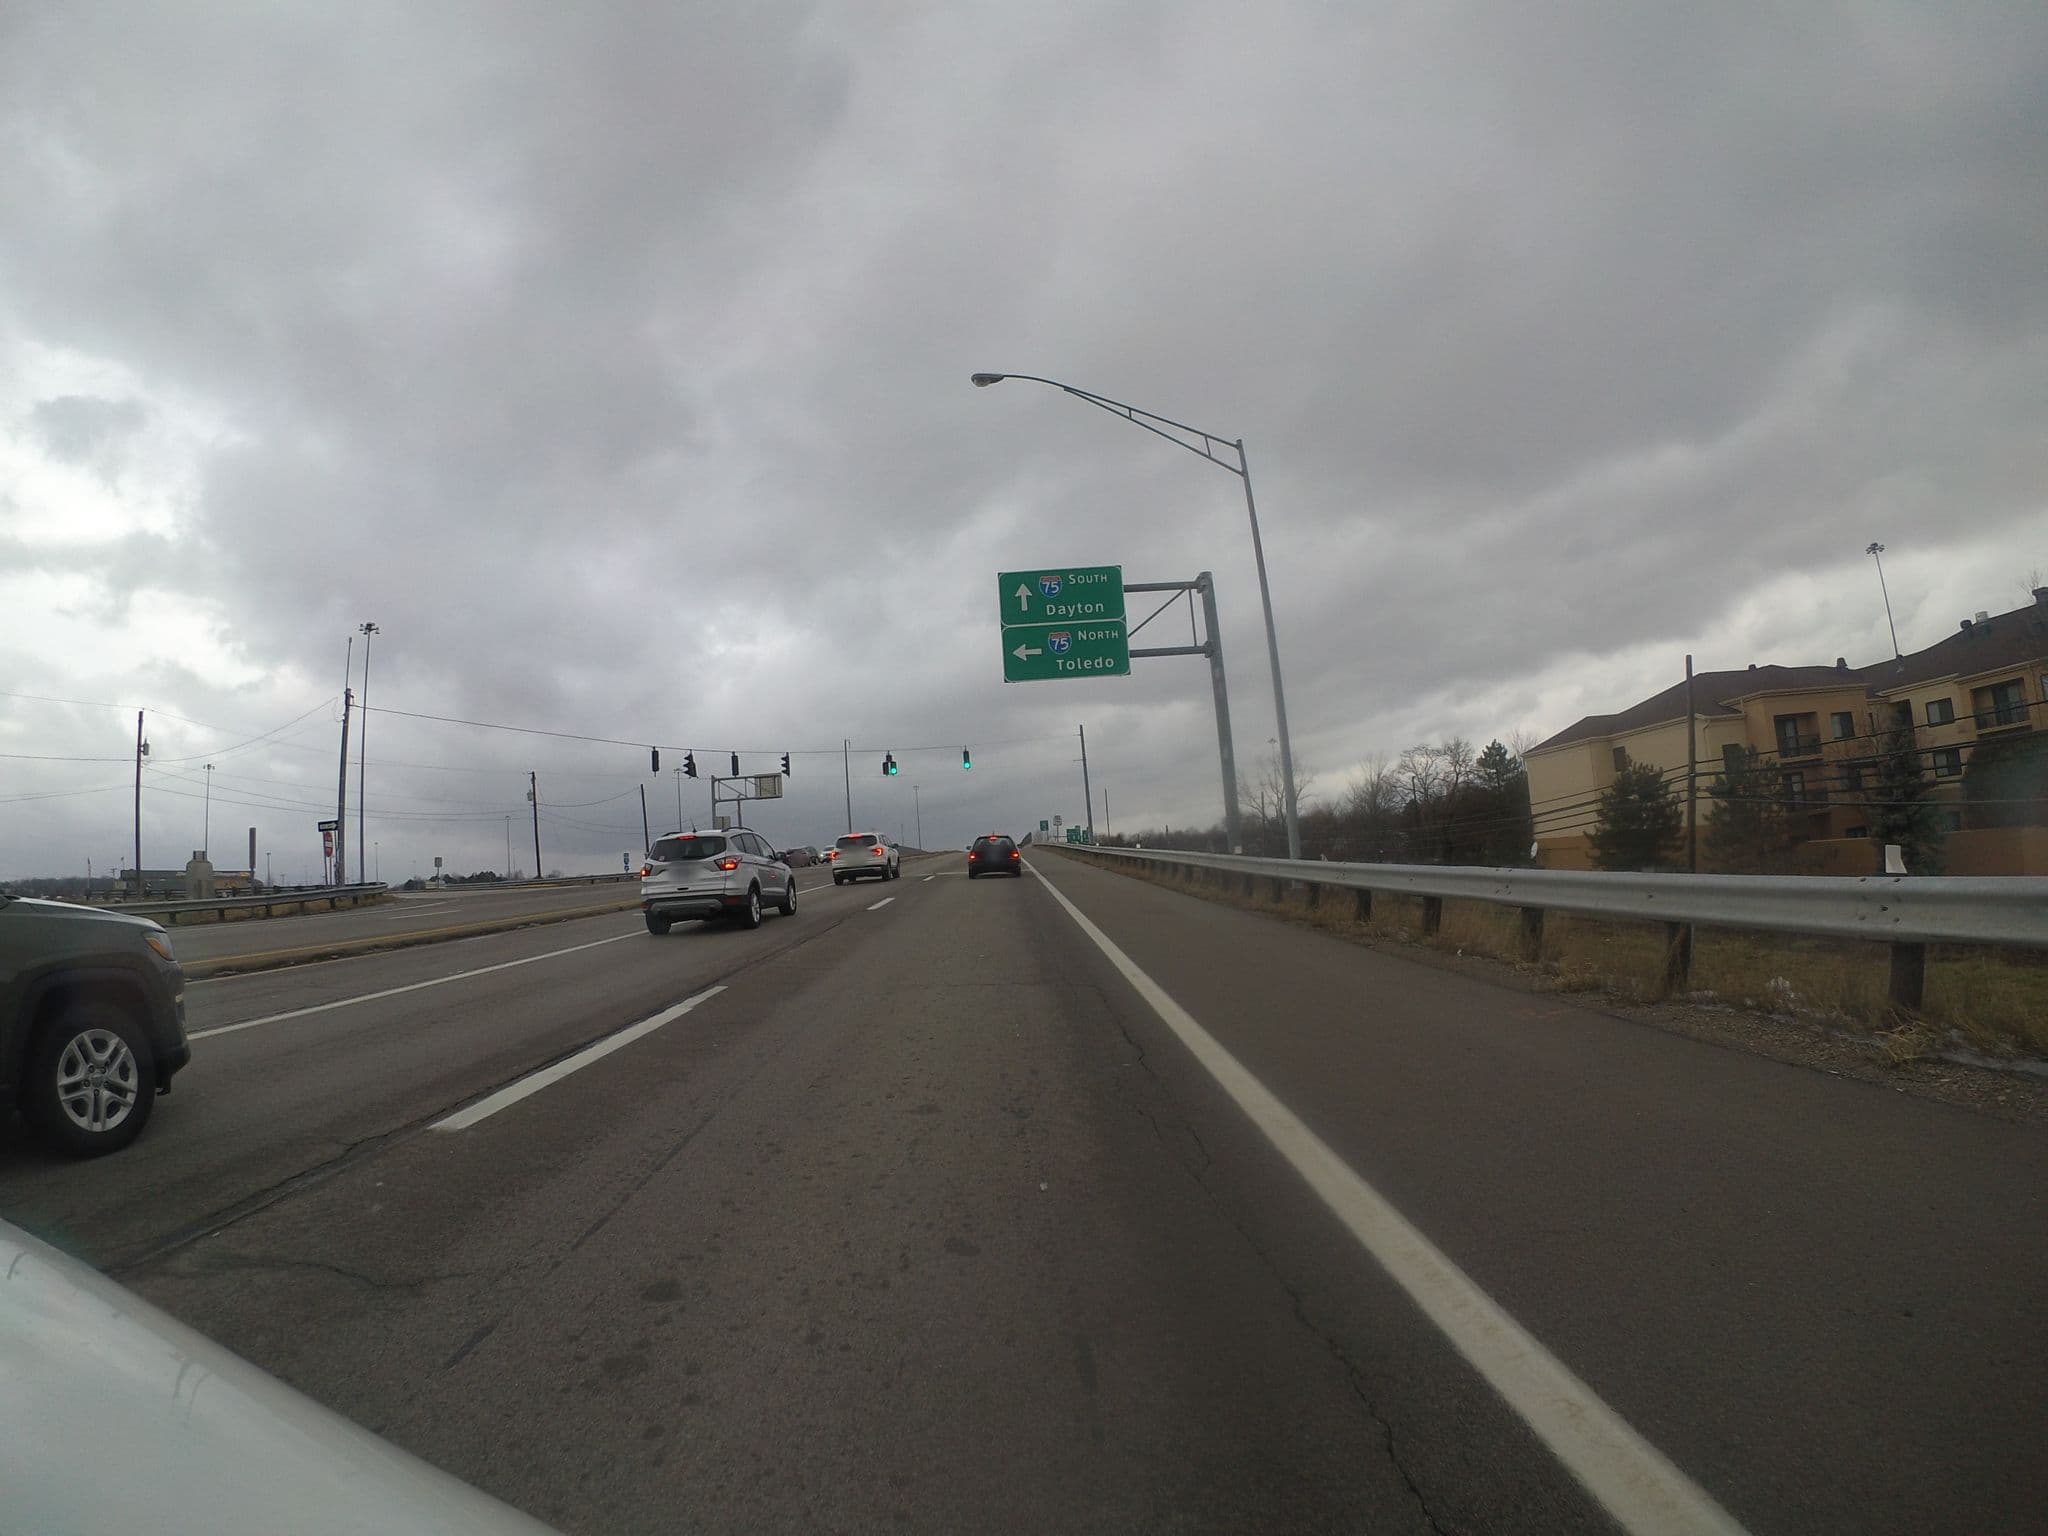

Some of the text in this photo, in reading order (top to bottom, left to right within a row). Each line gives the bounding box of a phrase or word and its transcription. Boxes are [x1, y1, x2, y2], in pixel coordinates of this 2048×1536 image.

[1042, 574, 1108, 594] 75 SOUTH
[1046, 603, 1104, 617] Dayton
[1052, 630, 1119, 650] 75 NORTH
[1056, 657, 1114, 670] Toledo
